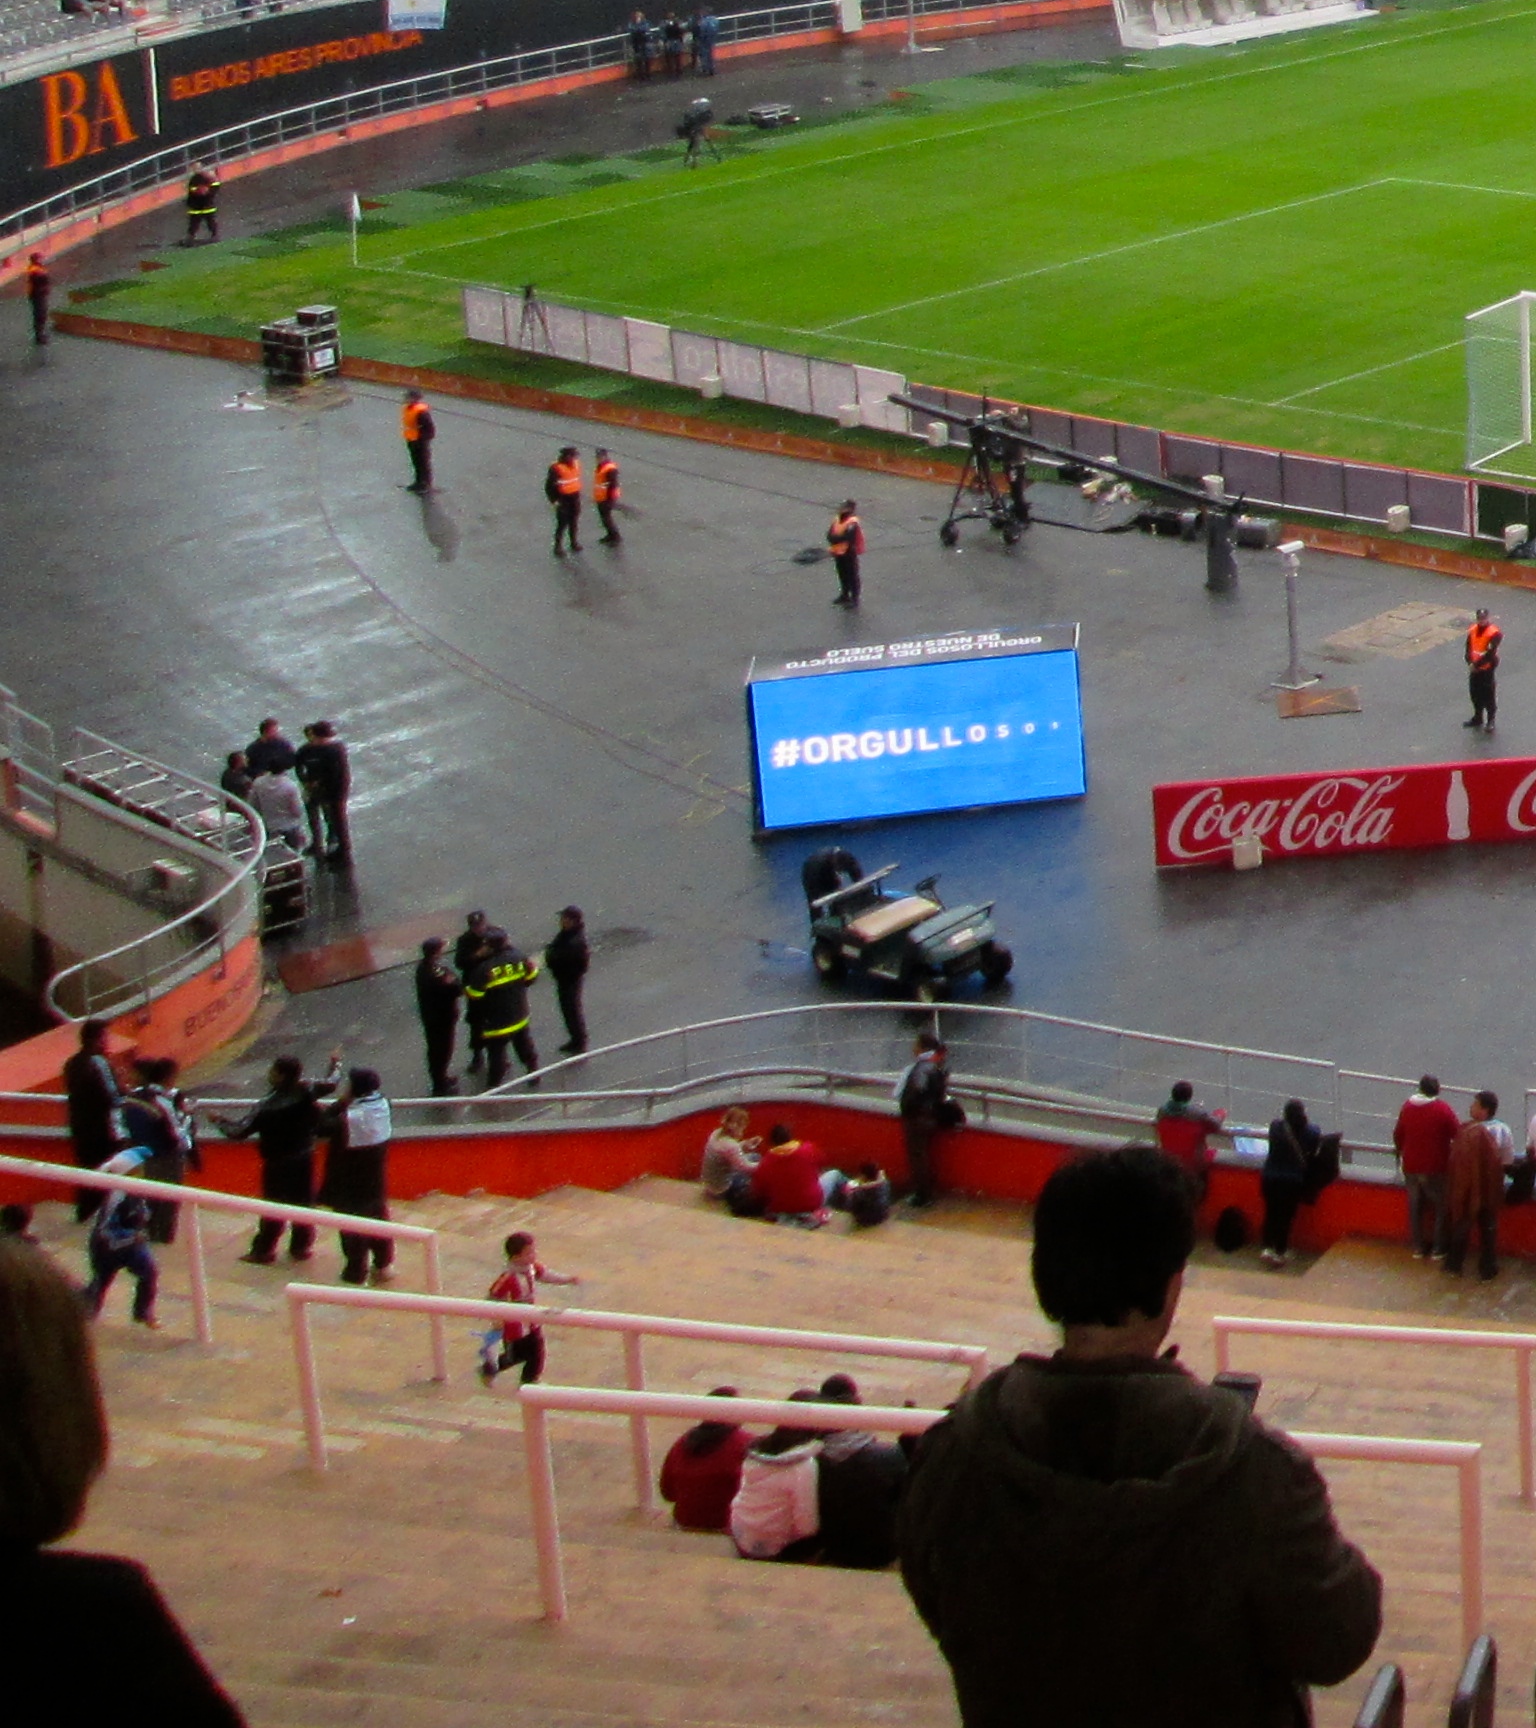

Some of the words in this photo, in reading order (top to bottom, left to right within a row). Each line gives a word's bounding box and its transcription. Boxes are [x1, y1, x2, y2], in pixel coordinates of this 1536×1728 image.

[170, 61, 250, 101] BUENOS
[252, 47, 313, 78] AIRES
[312, 29, 424, 68] PROVINCIA
[41, 60, 140, 169] BA
[827, 644, 884, 658] SUELO
[1168, 773, 1407, 858] Coca-Cola
